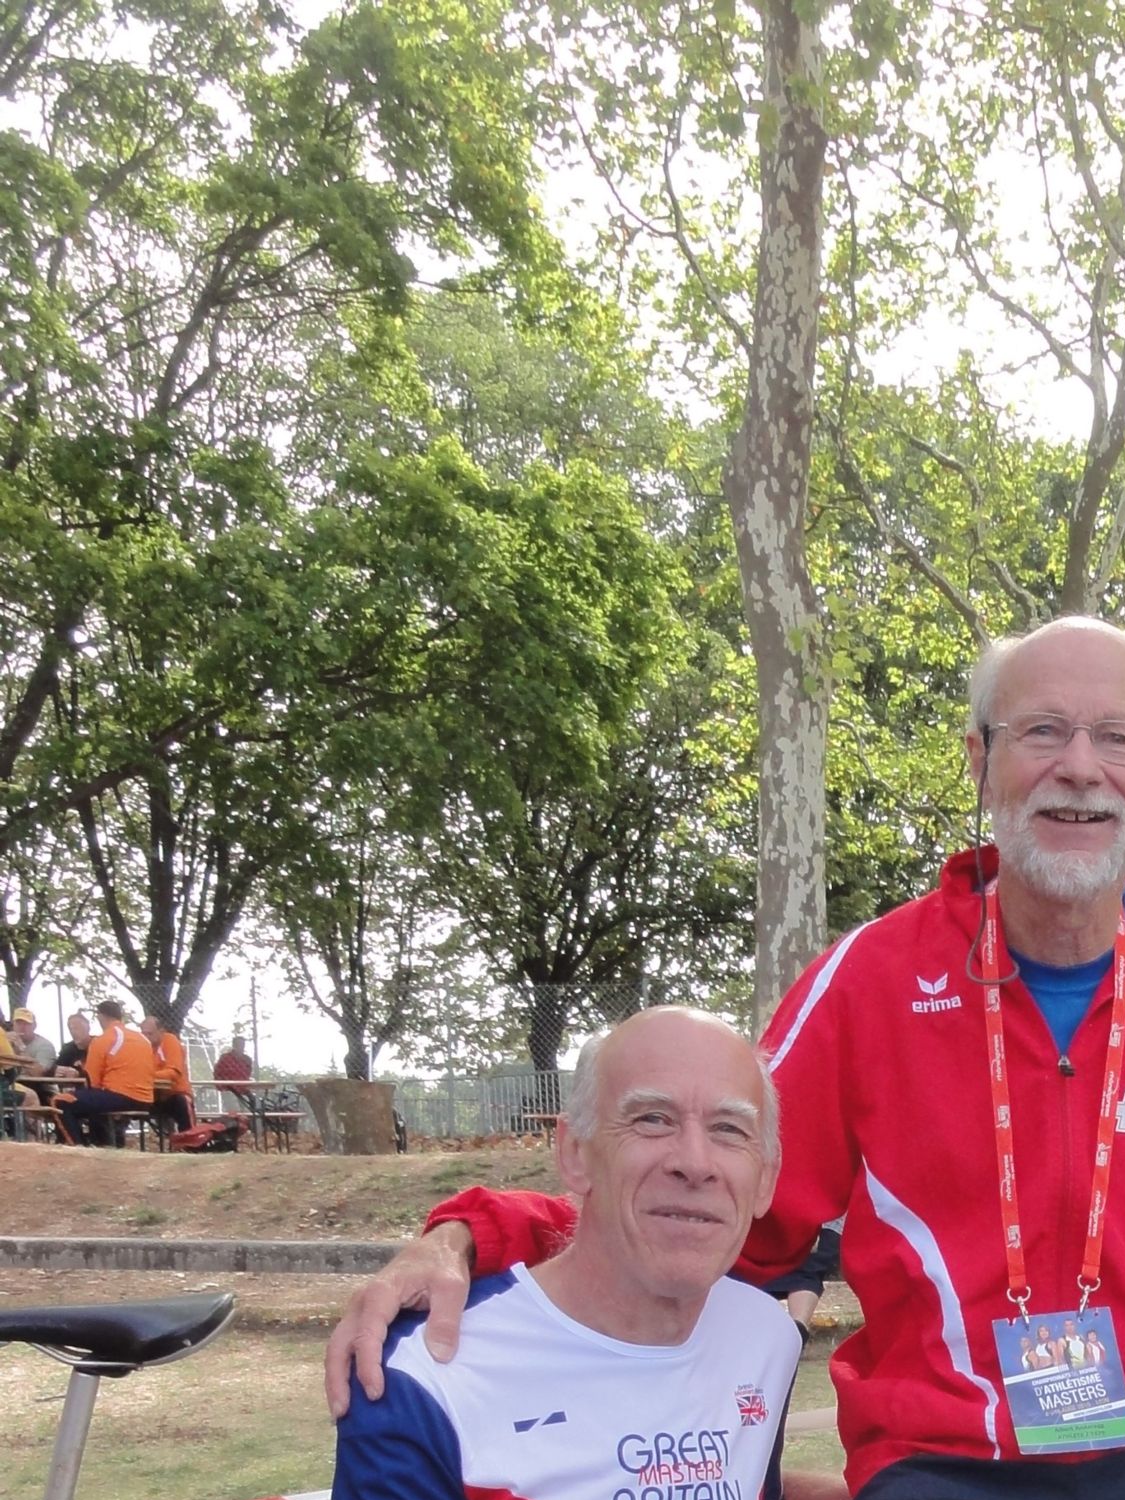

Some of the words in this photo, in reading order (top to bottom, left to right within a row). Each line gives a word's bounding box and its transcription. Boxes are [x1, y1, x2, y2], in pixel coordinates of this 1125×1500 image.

[912, 996, 962, 1013] erima
[1034, 1372, 1102, 1397] D'ATHLÉTISME
[1038, 1383, 1107, 1411] MASTERS
[617, 1430, 729, 1474] GREAT
[638, 1459, 723, 1486] MASTERS
